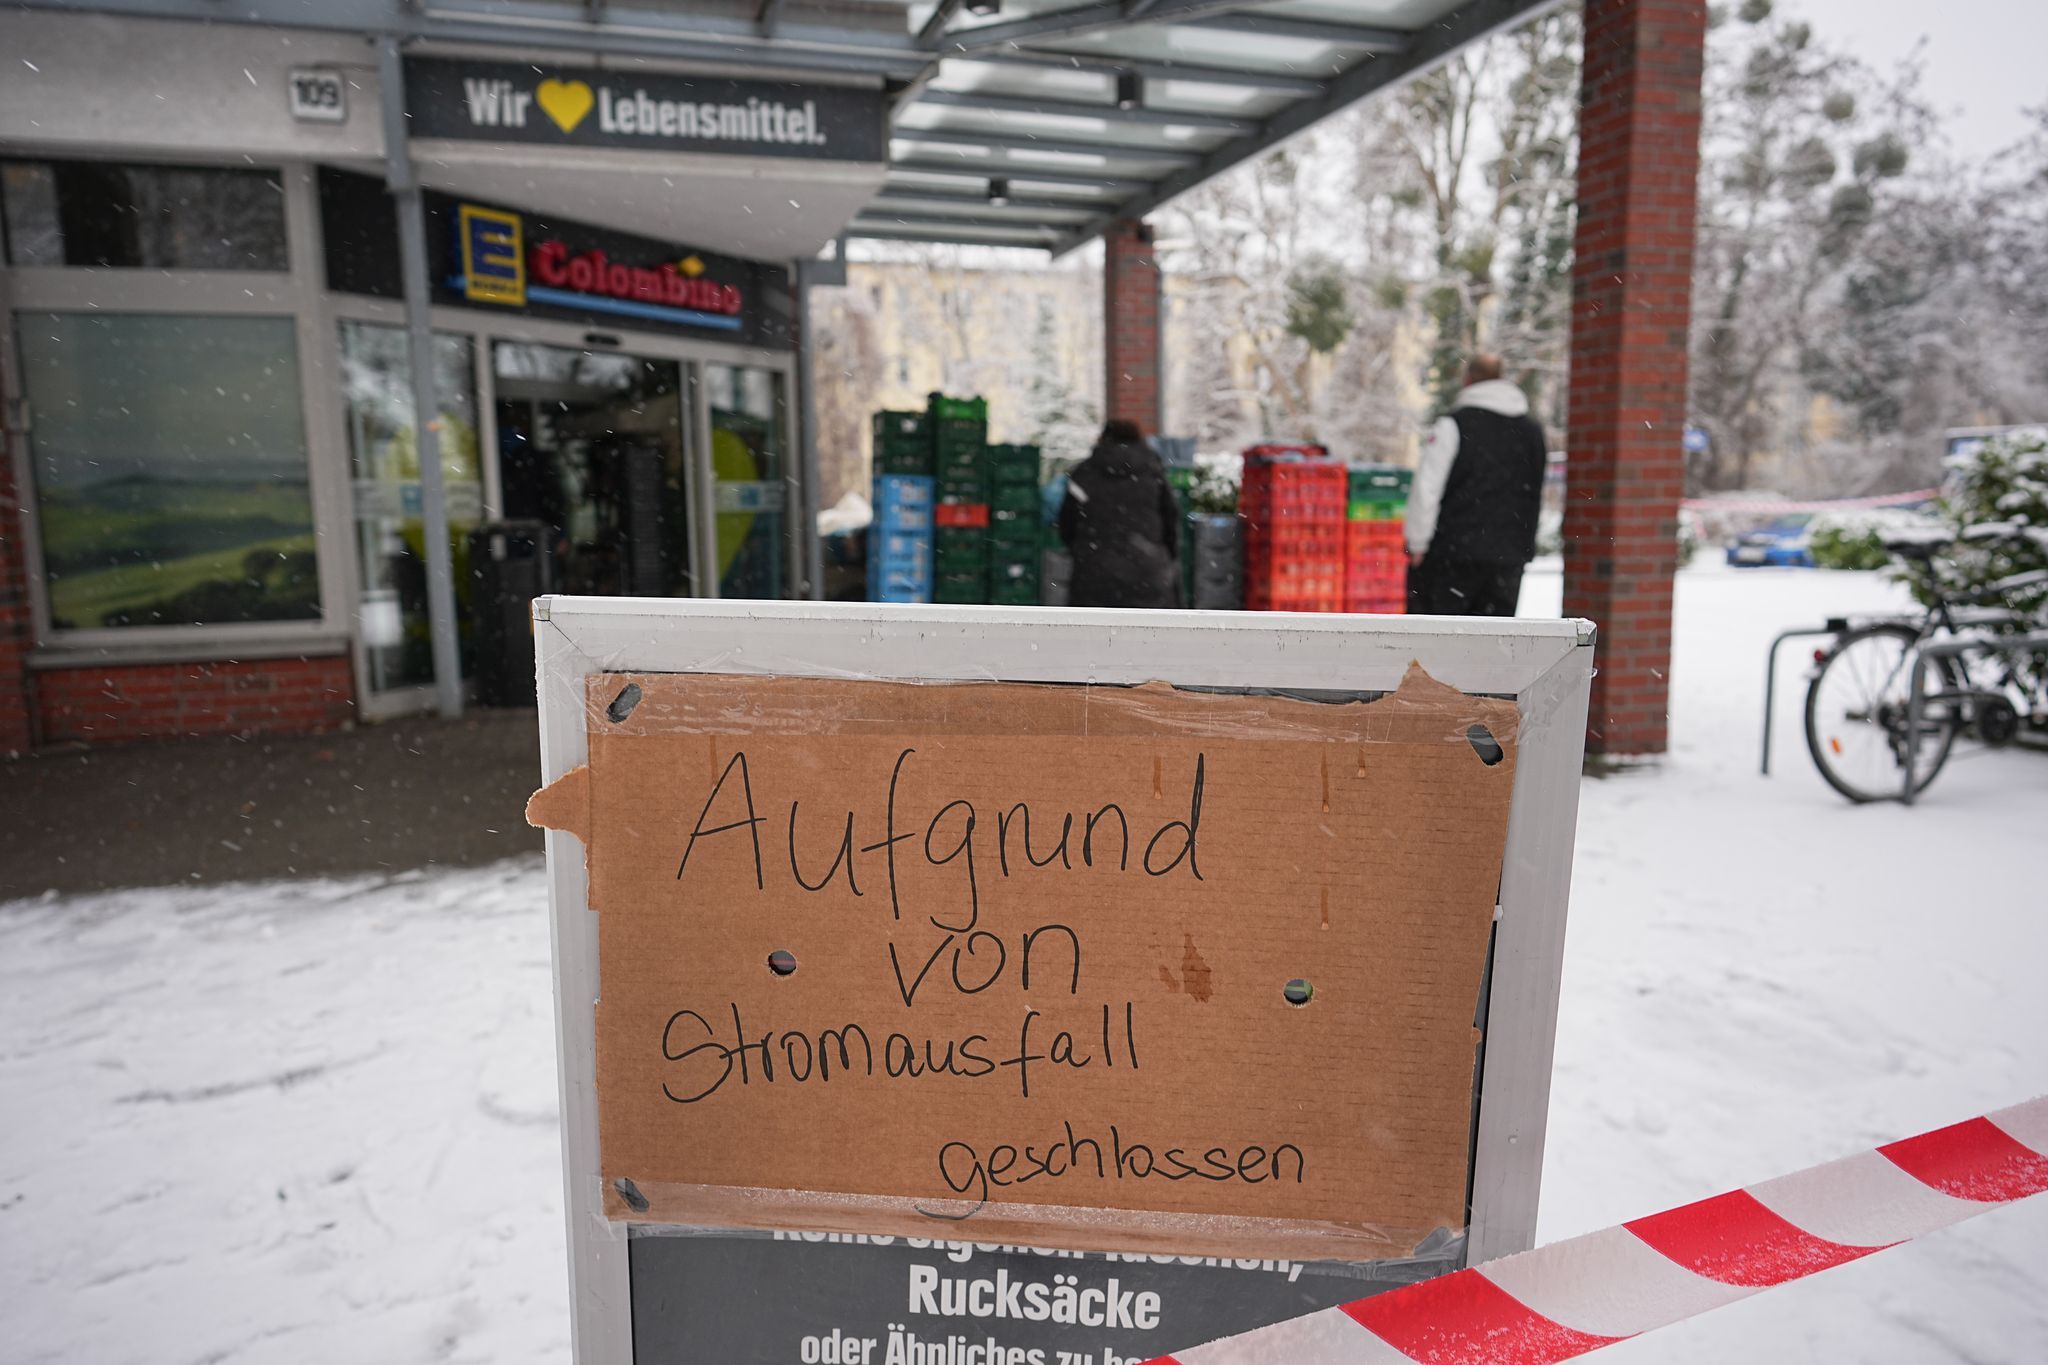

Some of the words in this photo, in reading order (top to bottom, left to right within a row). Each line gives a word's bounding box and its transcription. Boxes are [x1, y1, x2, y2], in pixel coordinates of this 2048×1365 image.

[297, 79, 337, 107] 109
[463, 79, 531, 127] Wir
[600, 86, 827, 145] Lebensmittel.
[532, 240, 742, 314] Colombino
[677, 748, 1204, 933] Aufgrund
[889, 923, 1080, 1007] von
[662, 1001, 1140, 1104] Stromausfall
[914, 1120, 1305, 1220] geschlossen
[908, 1263, 1161, 1330] Rucksäcke
[800, 1328, 877, 1365] oder
